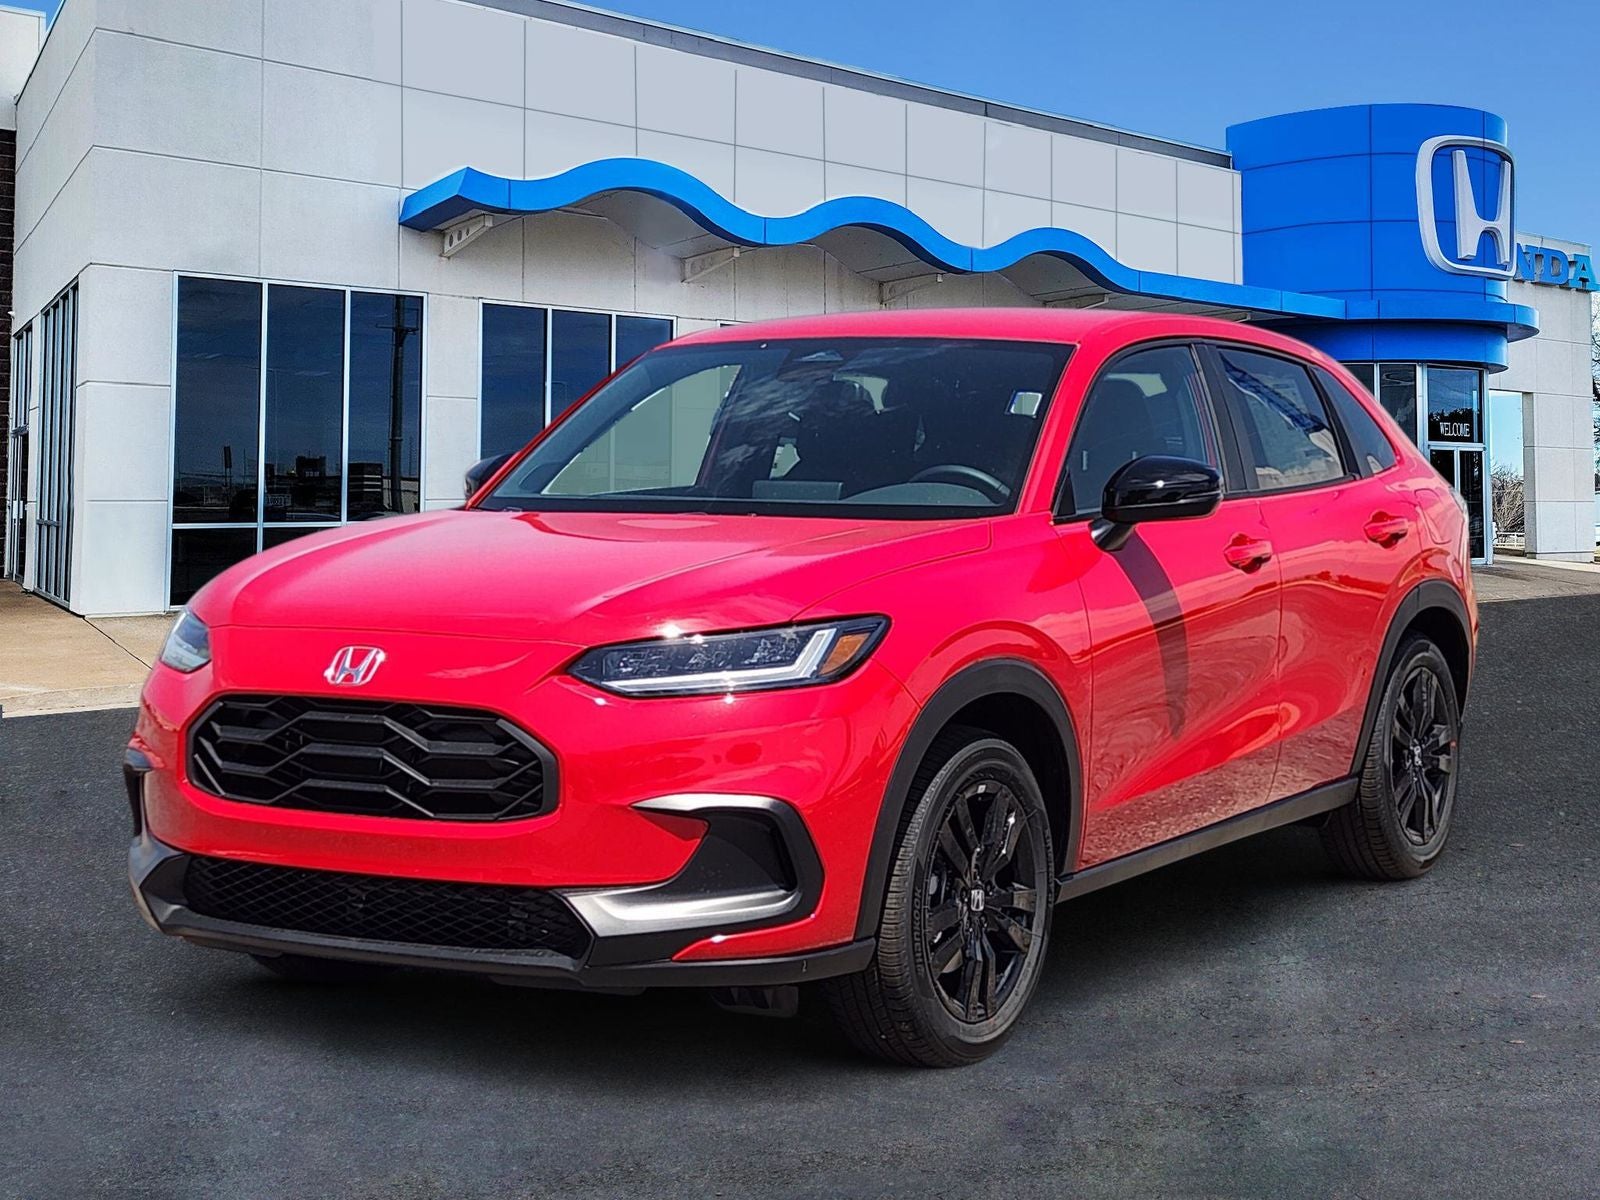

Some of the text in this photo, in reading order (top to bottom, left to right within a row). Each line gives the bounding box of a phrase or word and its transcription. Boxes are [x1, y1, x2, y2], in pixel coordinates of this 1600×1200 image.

[1514, 243, 1600, 291] NDA
[1440, 421, 1471, 437] WELCOME
[334, 646, 378, 685] H
